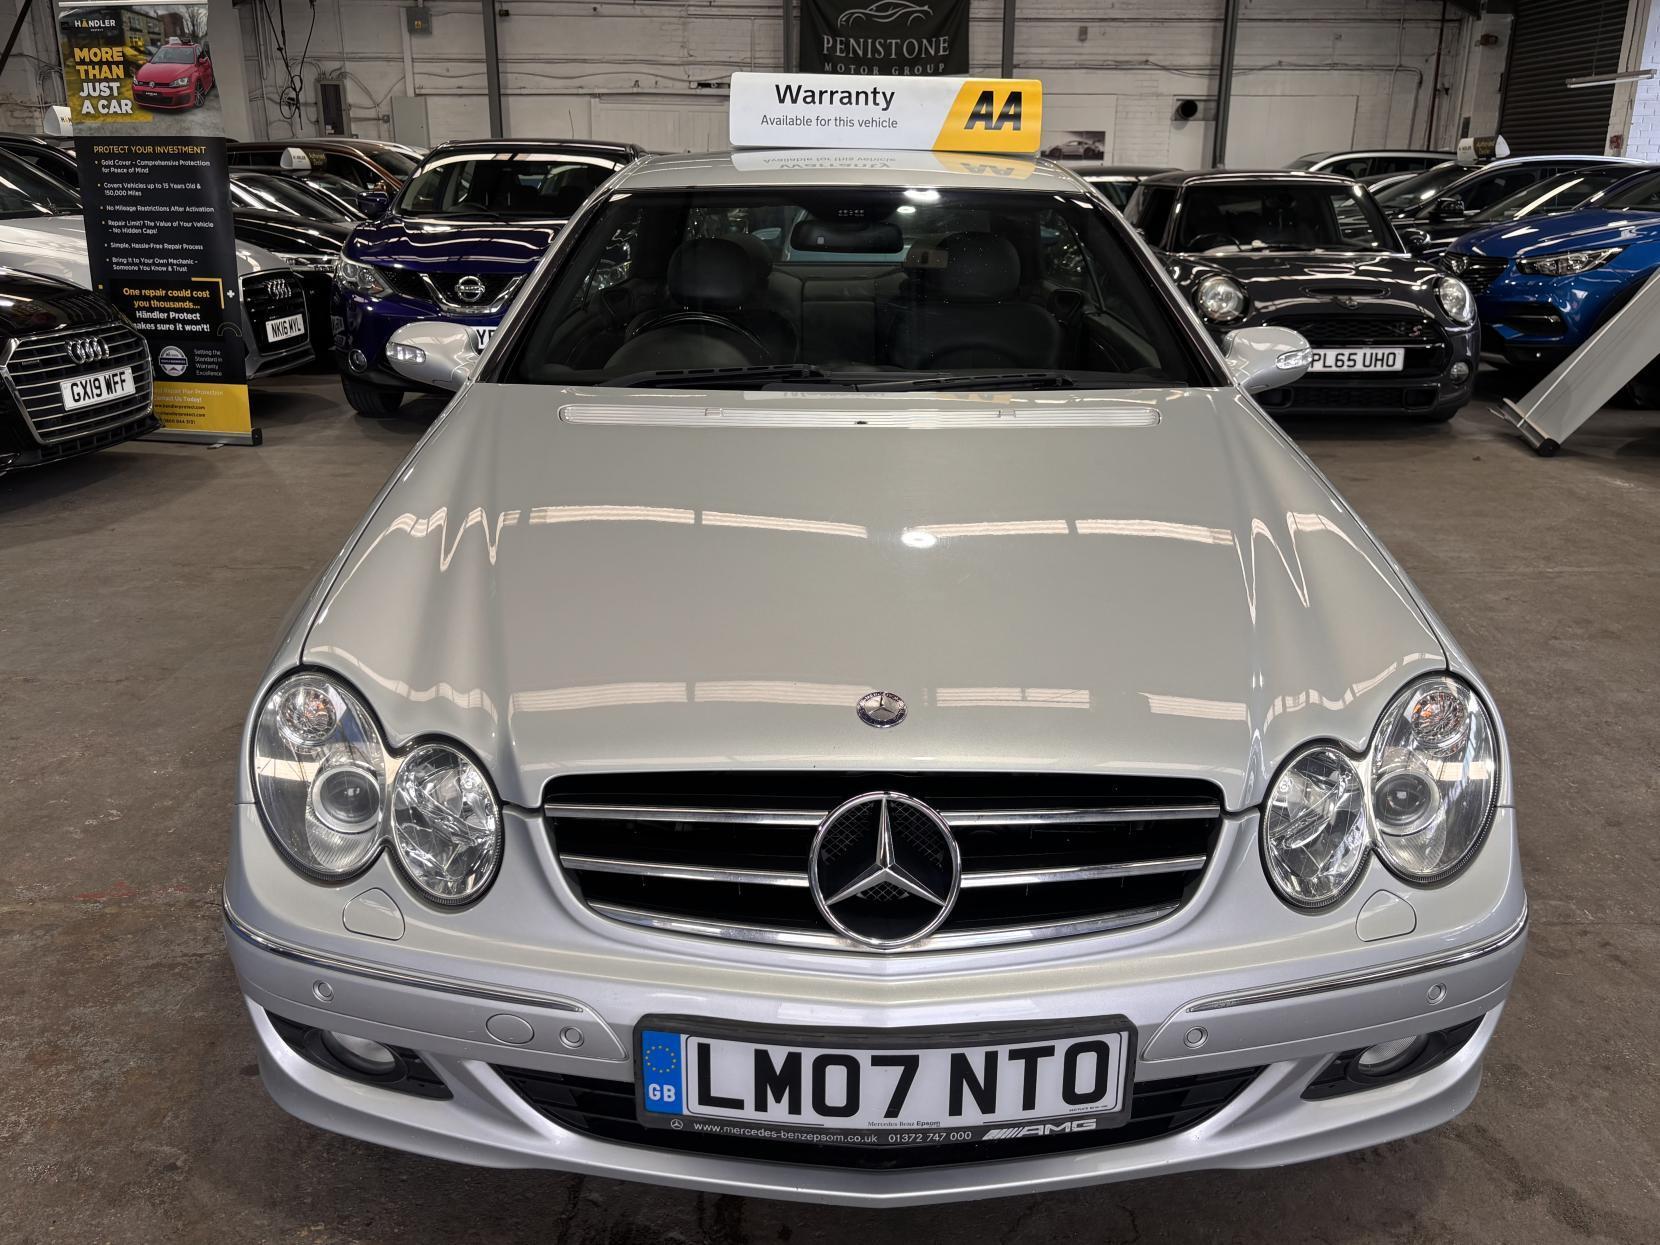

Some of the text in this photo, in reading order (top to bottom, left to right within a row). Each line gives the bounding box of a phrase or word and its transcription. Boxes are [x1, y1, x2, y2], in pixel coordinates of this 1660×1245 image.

[823, 34, 949, 59] PENISTONE
[74, 47, 124, 62] MORE
[76, 65, 125, 79] THAN
[824, 62, 945, 76] MOTOR GROUP
[80, 82, 120, 97] JUST
[775, 84, 896, 111] Warranty
[81, 99, 133, 114] A CAR
[964, 90, 1022, 132] AA
[760, 114, 898, 129] Available for this vehicle
[93, 145, 207, 155] PROTECT YOUR INVESTMENT
[136, 160, 179, 168] Comprehensive
[123, 287, 211, 298] One repair could cost
[133, 300, 201, 309] you thousands...
[135, 310, 201, 320] Händler Protect
[156, 323, 175, 331] sure
[184, 323, 211, 332] won't!
[1310, 352, 1397, 369] PL65 UHO
[70, 371, 126, 403] GX19 WFF
[697, 1039, 1110, 1119] LM07 NTO
[648, 1083, 676, 1102] GB
[916, 1119, 941, 1127] Epsom
[1014, 1118, 1097, 1138] AMG
[693, 1121, 972, 1144] www.mercedes-benzepsom.co.uk 01372 747 000
